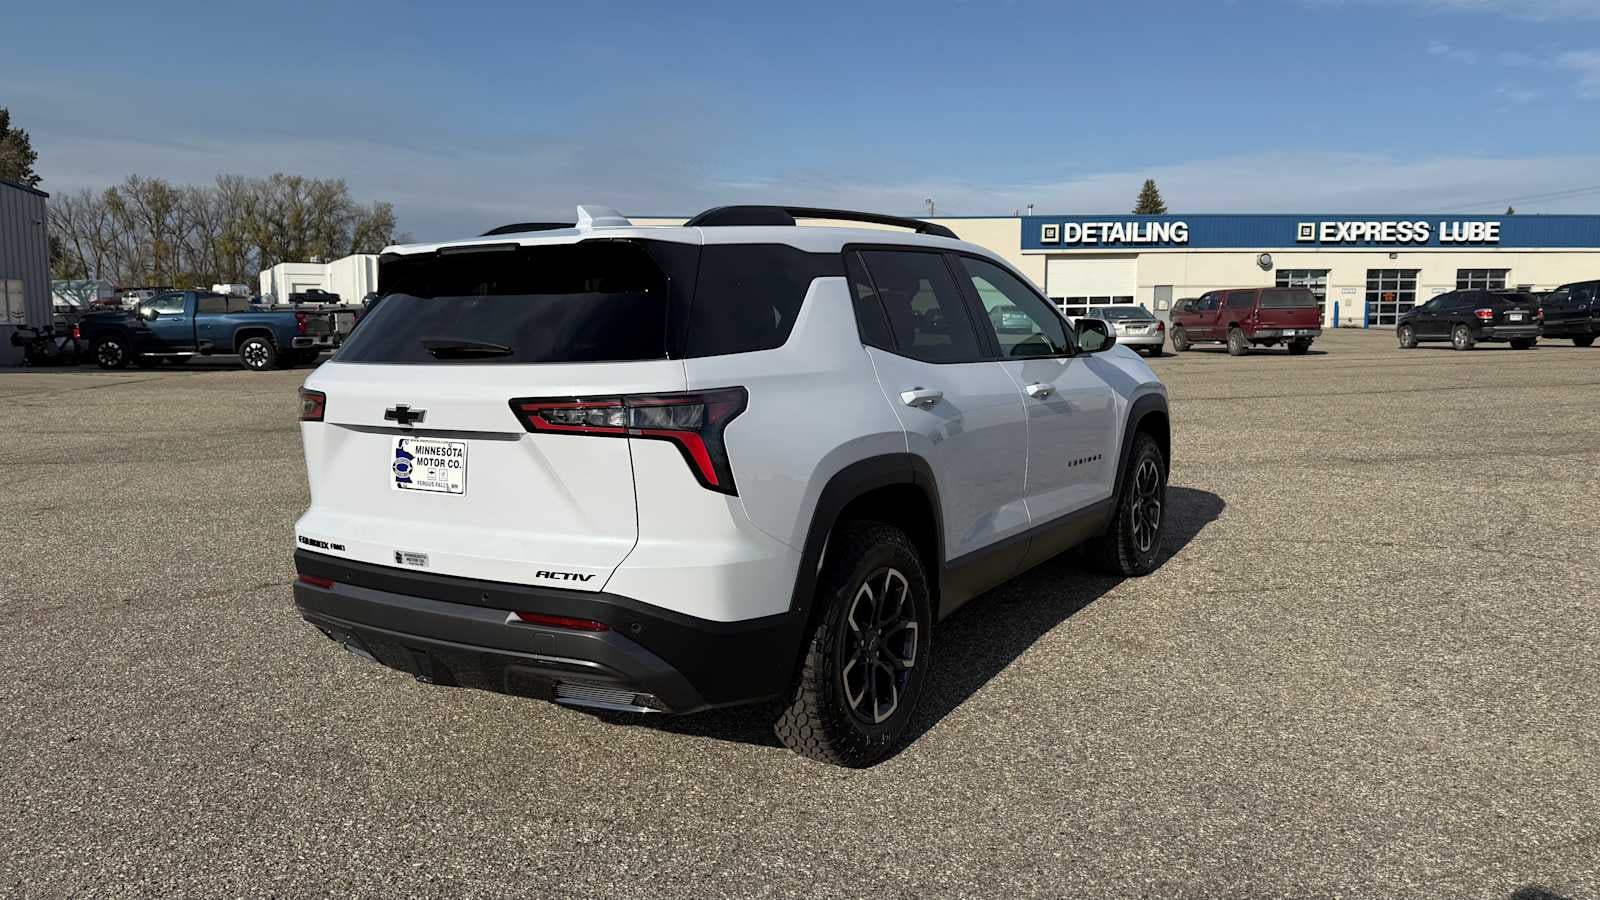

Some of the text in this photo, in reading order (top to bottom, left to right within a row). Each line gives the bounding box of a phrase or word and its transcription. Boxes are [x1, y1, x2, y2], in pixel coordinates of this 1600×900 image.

[1064, 221, 1189, 243] DETAILING
[1319, 221, 1501, 242] EXPRESS LUBE
[415, 445, 463, 458] MINNESOTA
[416, 457, 446, 468] MOTOR
[447, 459, 462, 469] CO.
[535, 570, 597, 582] ACTIV
